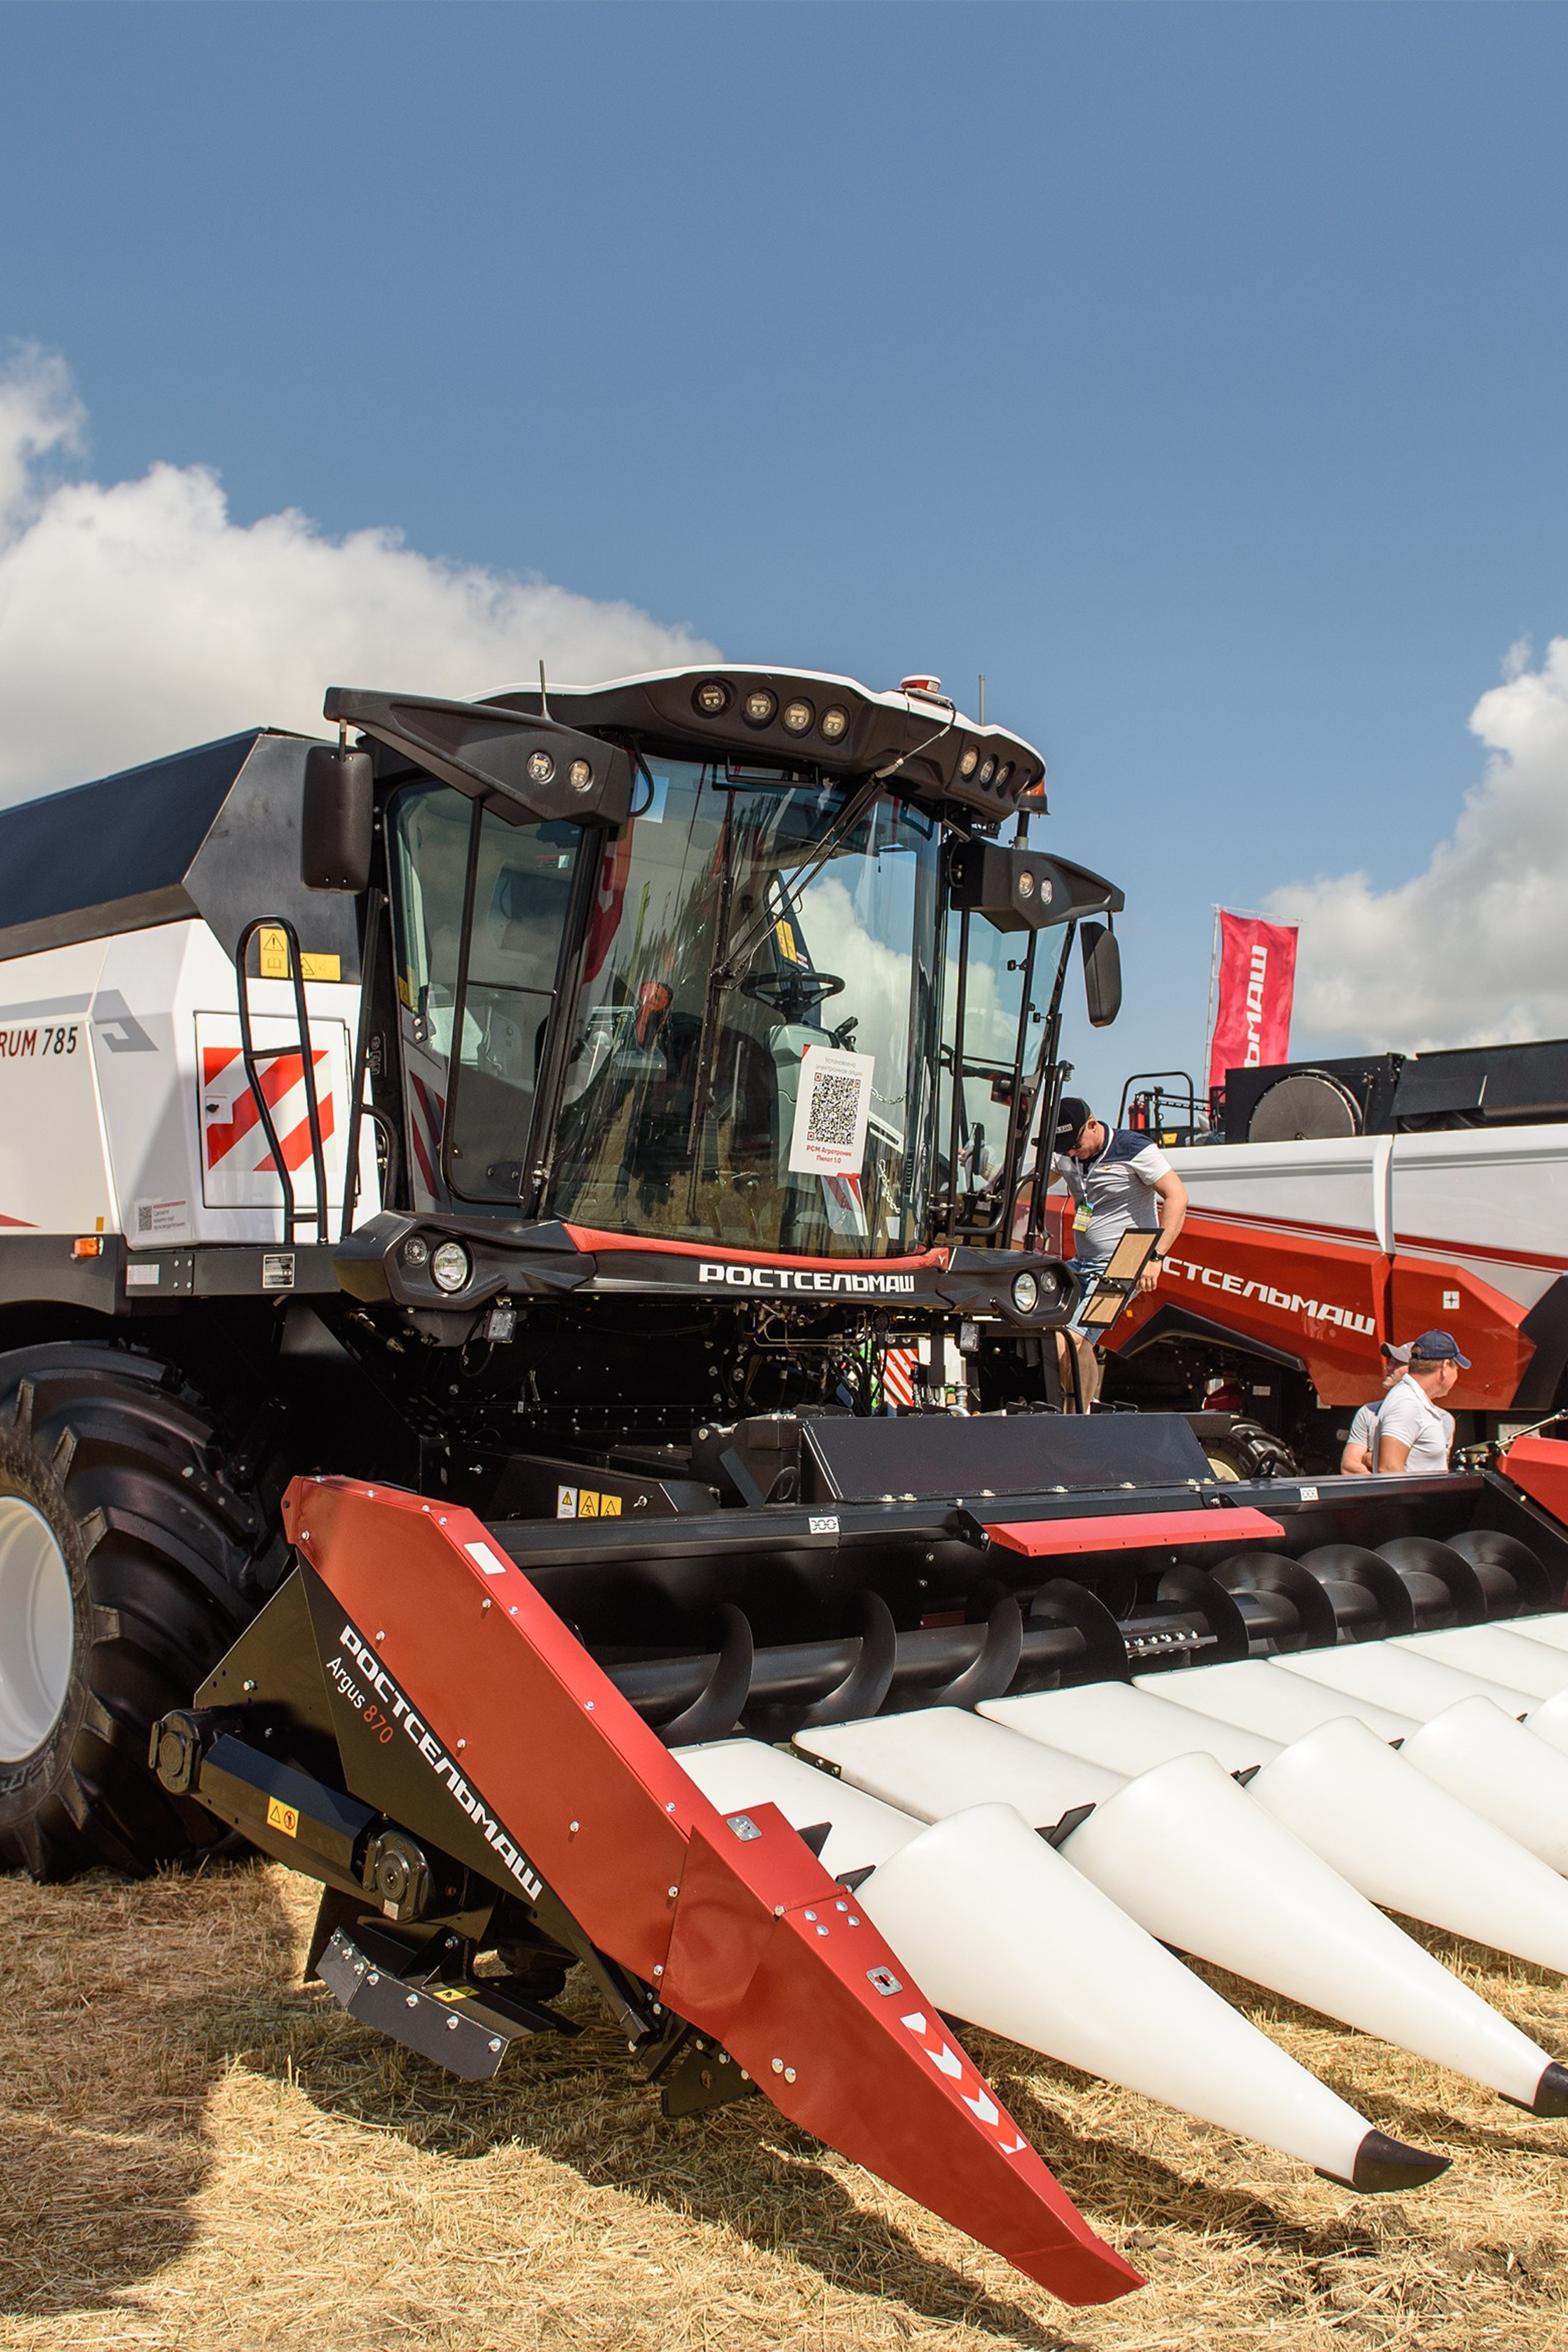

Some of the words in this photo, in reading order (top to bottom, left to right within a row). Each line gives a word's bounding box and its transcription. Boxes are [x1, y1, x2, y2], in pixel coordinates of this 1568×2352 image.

[0, 1030, 37, 1057] RUM
[42, 1027, 78, 1055] 785
[821, 1147, 852, 1157] Агротроник
[699, 1264, 914, 1292] РОСТСЕЛЬМАШ
[1162, 1256, 1376, 1336] СТСЕЛЬМАШ
[326, 1657, 366, 1709] Argus
[363, 1705, 394, 1744] 870
[339, 1624, 543, 1901] РОСТСЕЛЬМАШ
